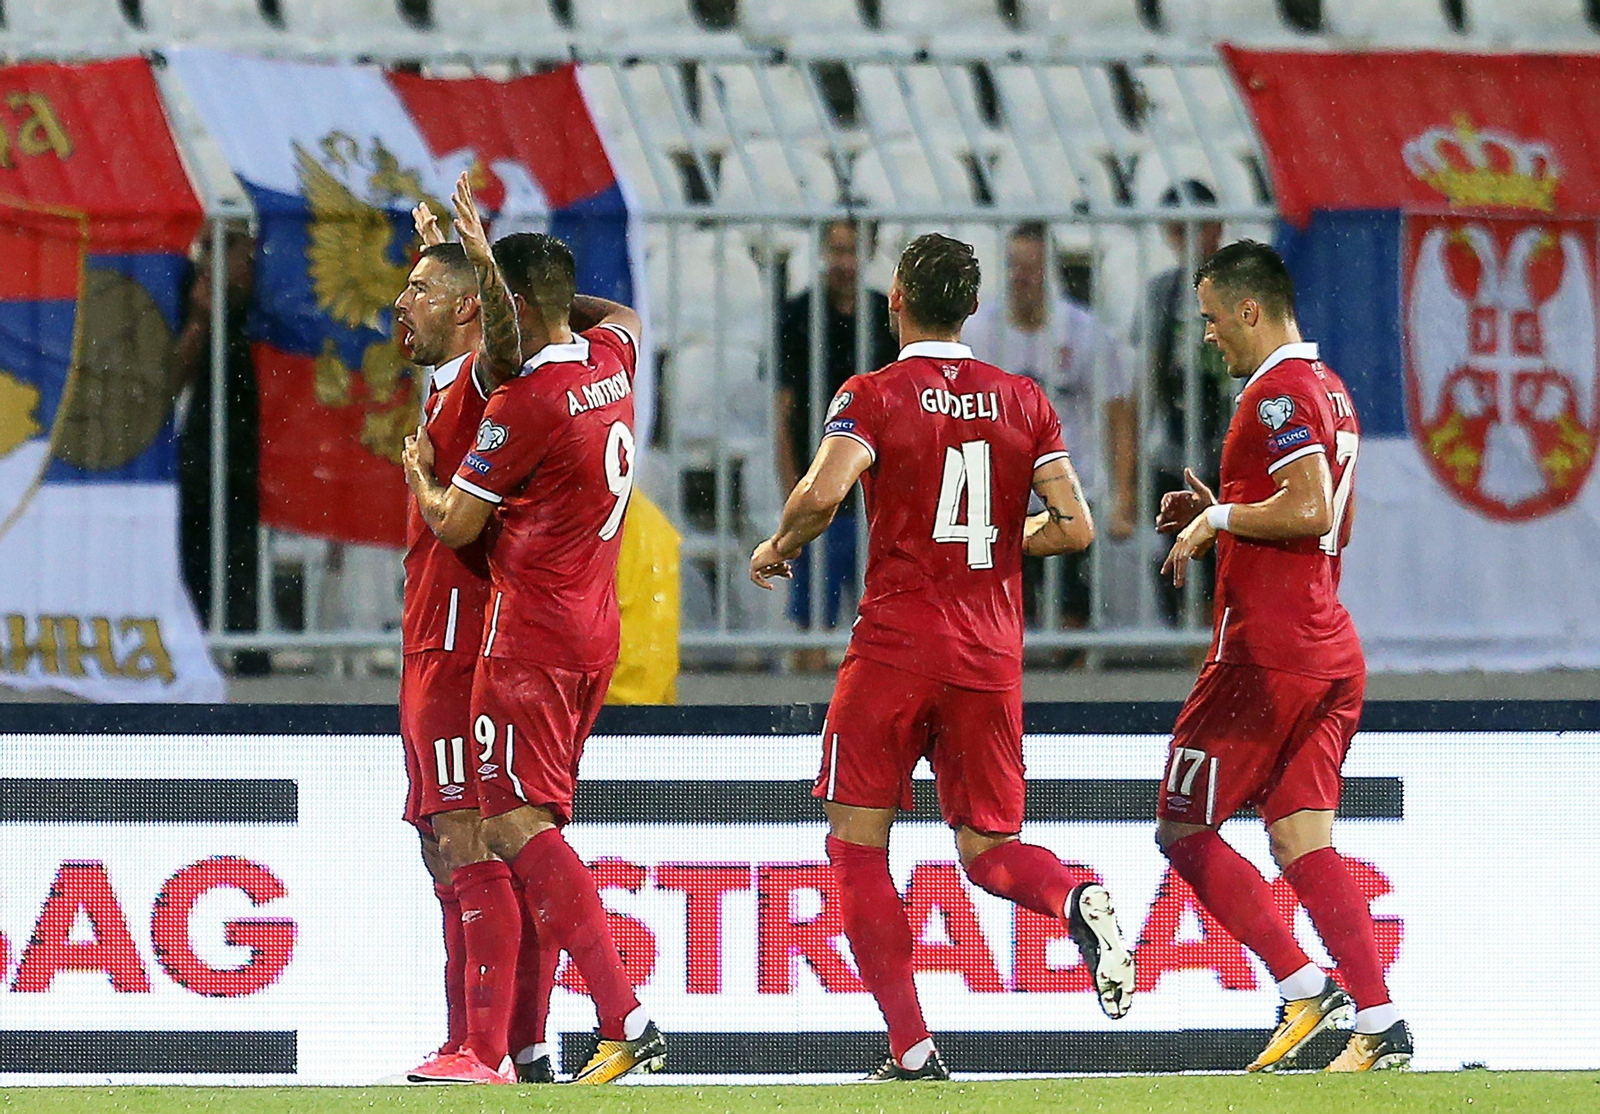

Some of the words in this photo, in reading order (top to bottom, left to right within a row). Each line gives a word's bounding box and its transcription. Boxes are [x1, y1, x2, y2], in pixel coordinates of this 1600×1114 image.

[921, 387, 999, 421] GUDELJ
[1277, 429, 1308, 446] RESPECT
[598, 420, 636, 542] 9
[932, 440, 999, 570] 4
[434, 736, 466, 786] 11
[474, 714, 496, 763] 9
[1166, 747, 1206, 796] 17
[0, 855, 298, 998] AG
